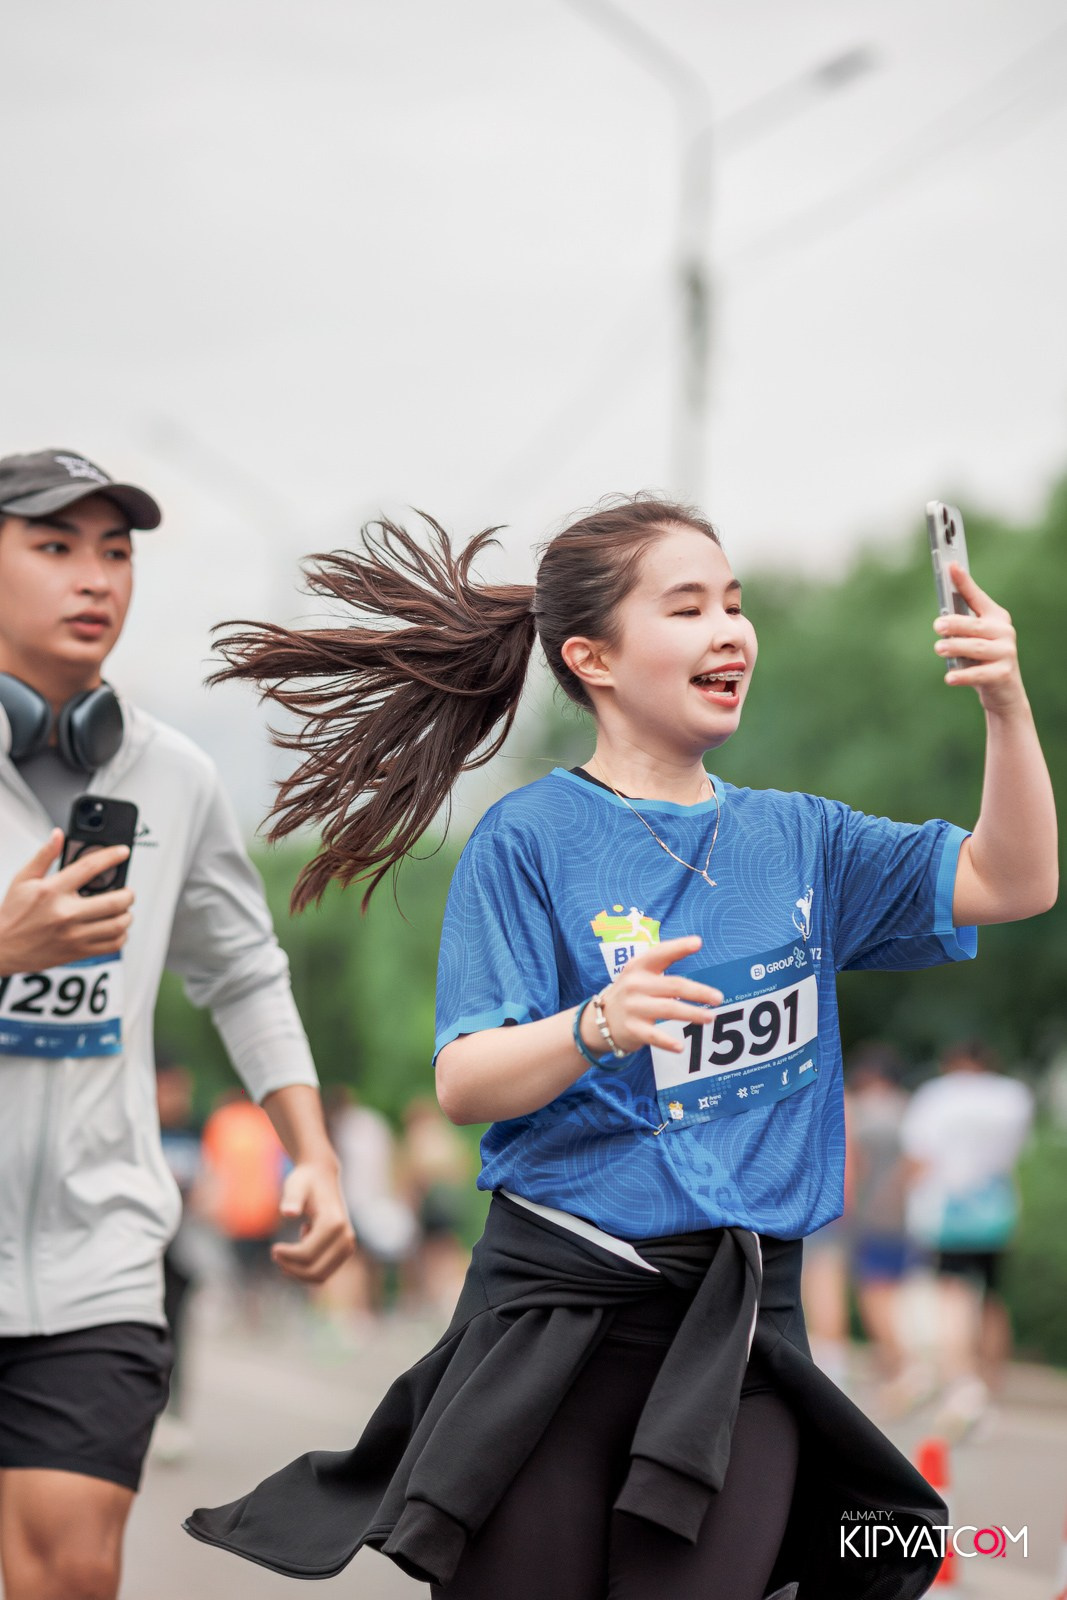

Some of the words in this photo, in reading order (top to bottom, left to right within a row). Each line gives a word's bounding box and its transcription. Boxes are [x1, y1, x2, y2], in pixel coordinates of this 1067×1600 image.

[614, 945, 635, 966] BI
[766, 956, 794, 973] GROUP
[683, 989, 800, 1074] 1591
